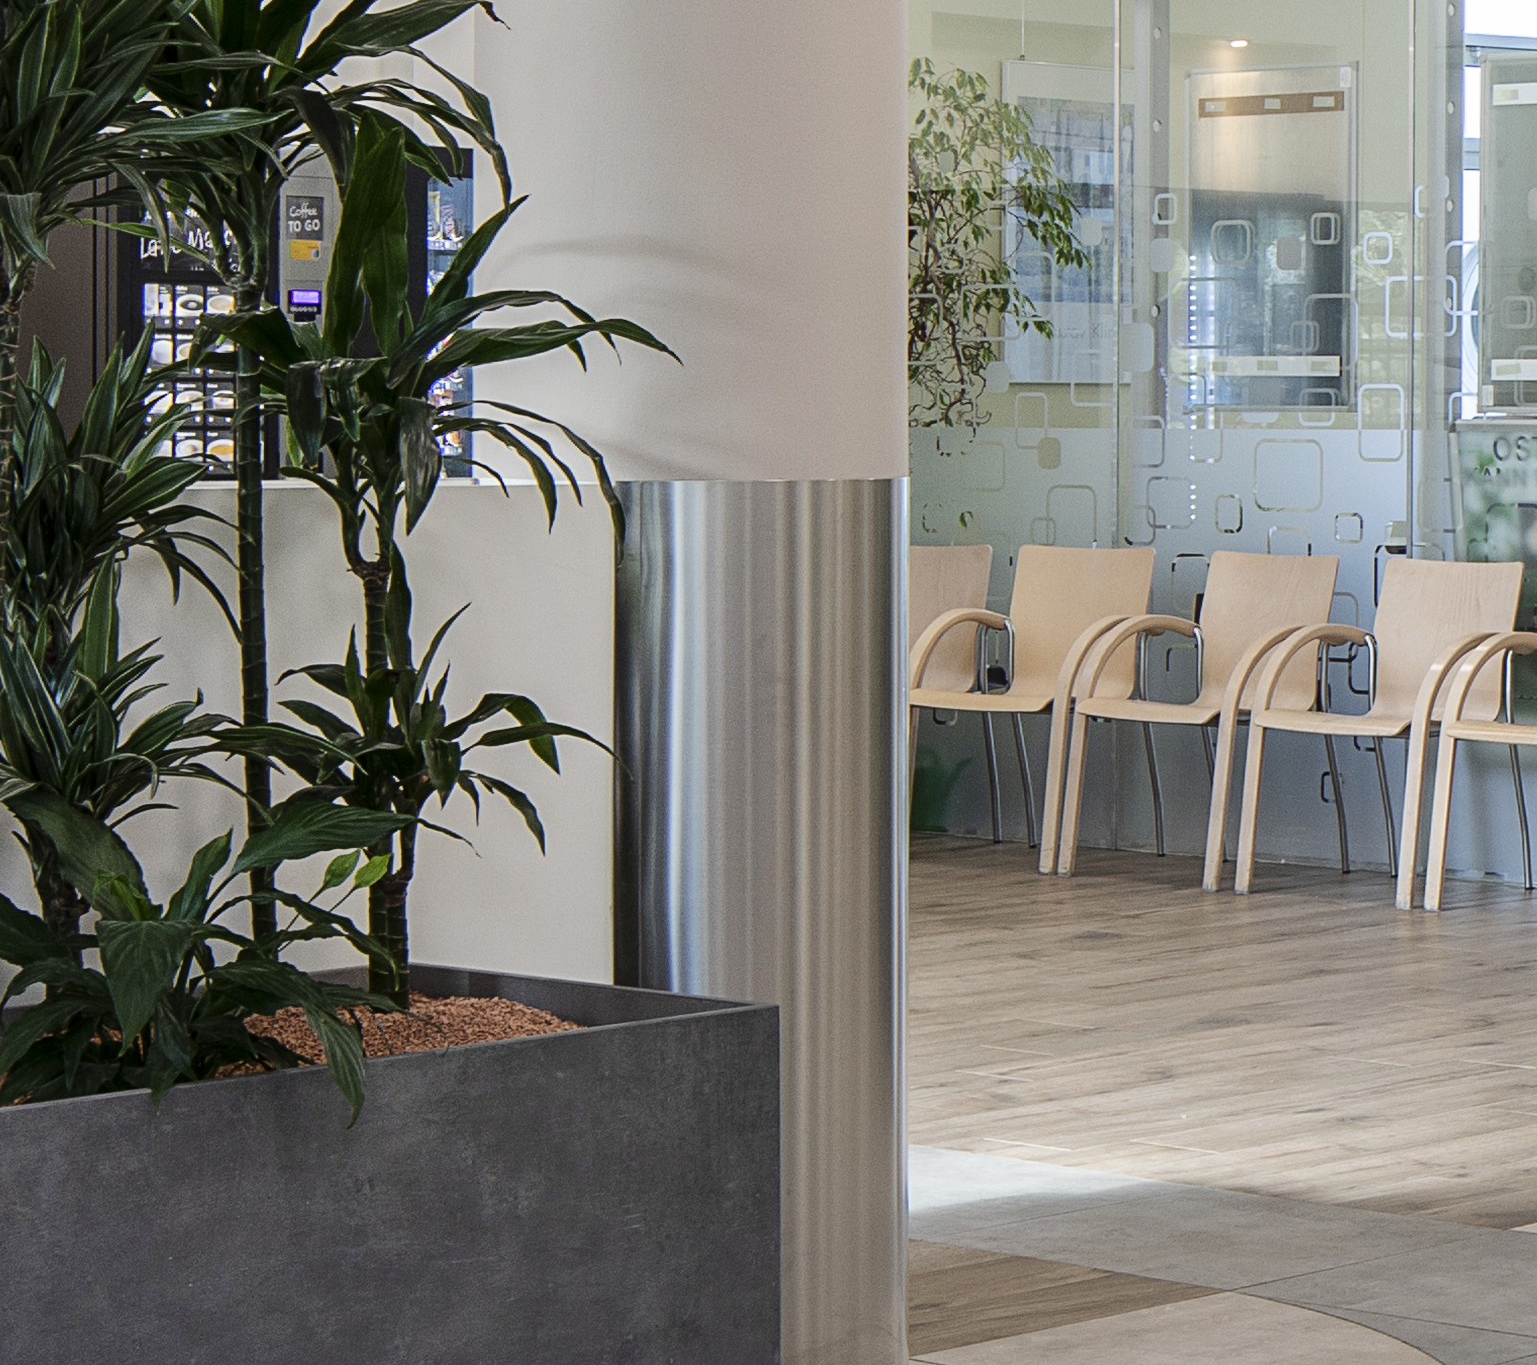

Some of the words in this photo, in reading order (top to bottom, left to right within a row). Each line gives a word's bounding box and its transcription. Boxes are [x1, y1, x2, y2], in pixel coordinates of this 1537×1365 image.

[289, 202, 318, 218] Coffee
[288, 220, 302, 233] TO
[304, 219, 320, 231] GO
